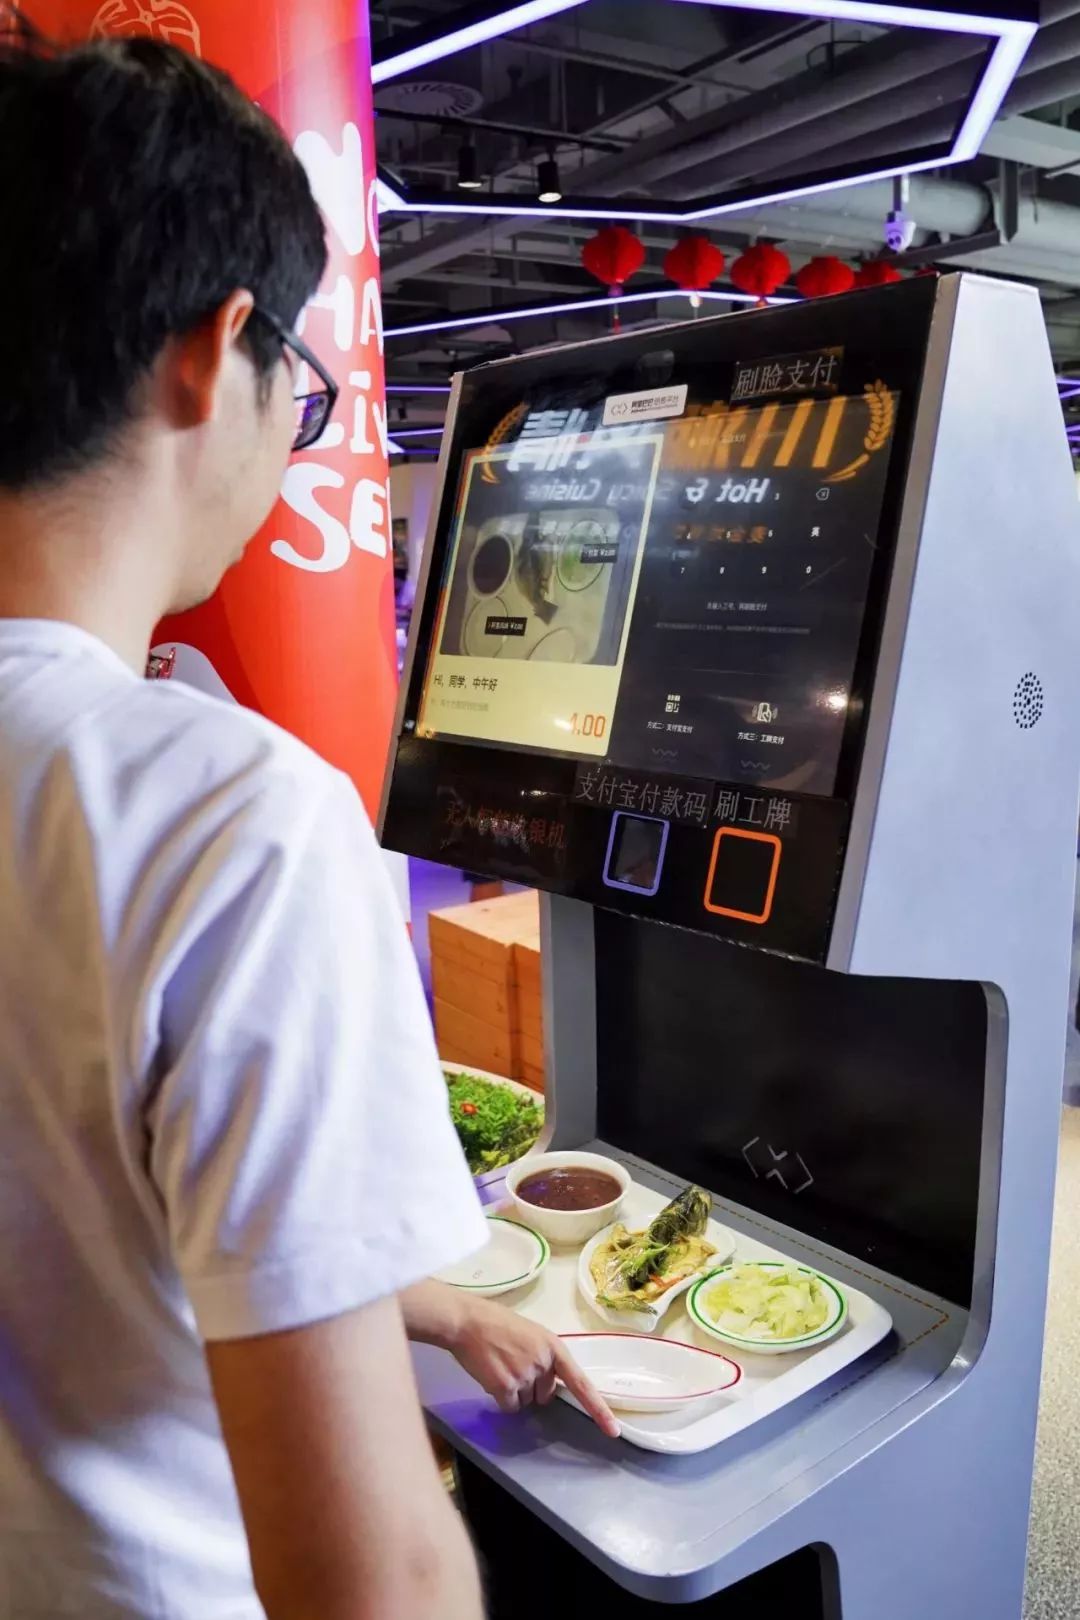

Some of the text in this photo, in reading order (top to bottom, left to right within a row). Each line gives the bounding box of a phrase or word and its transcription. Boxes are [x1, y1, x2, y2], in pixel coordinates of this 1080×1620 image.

[735, 355, 838, 397] 刷脸支付
[270, 462, 394, 572] SE
[576, 772, 707, 822] 支付宝付款码
[714, 790, 792, 831] 刷工牌
